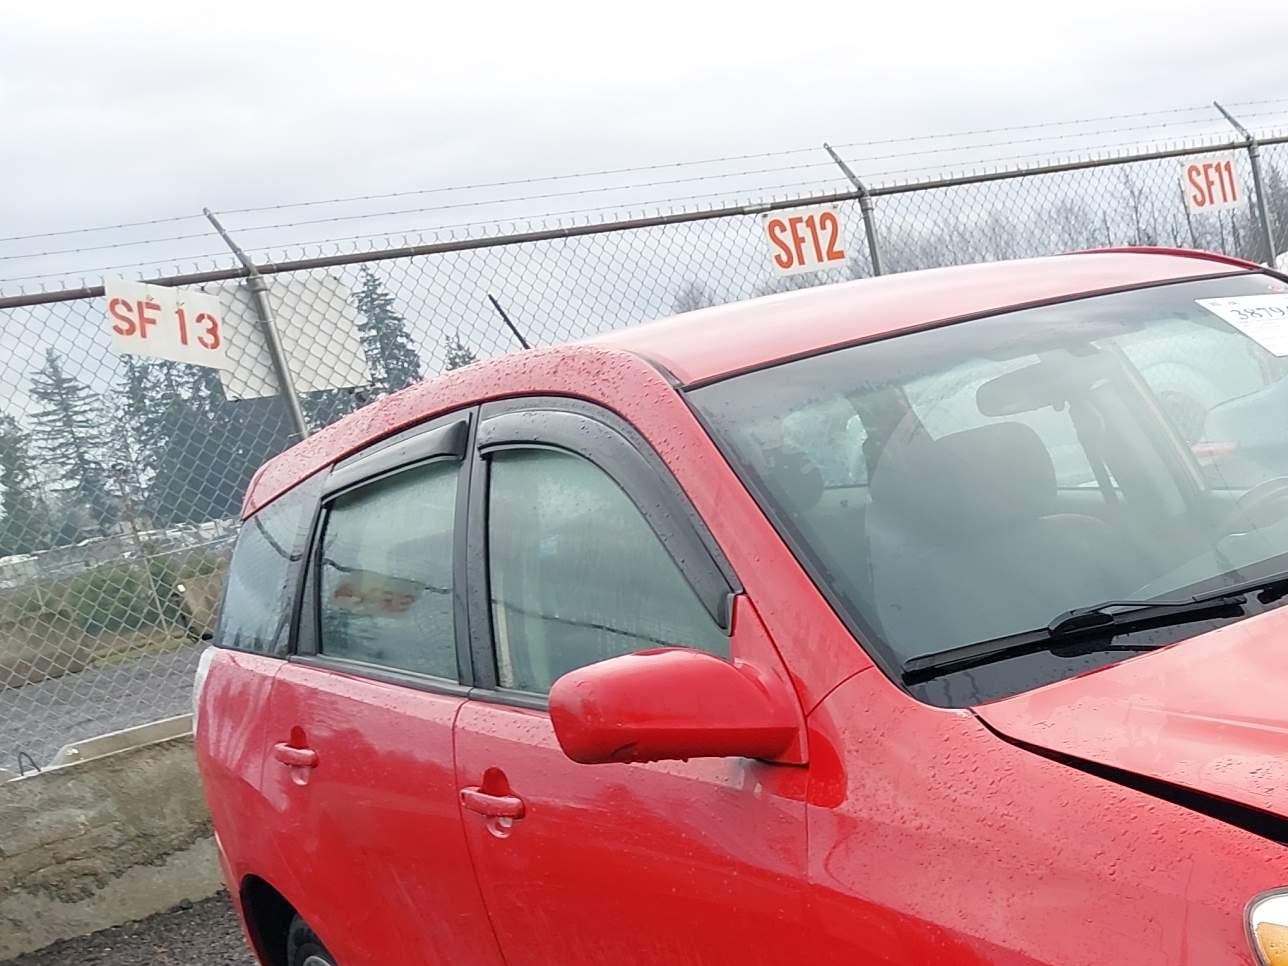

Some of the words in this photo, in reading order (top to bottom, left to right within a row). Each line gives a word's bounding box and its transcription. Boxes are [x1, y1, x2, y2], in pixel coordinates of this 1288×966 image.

[1187, 160, 1237, 207] SF11
[768, 212, 845, 269] SF12
[109, 298, 161, 338] SF
[175, 308, 220, 350] 13
